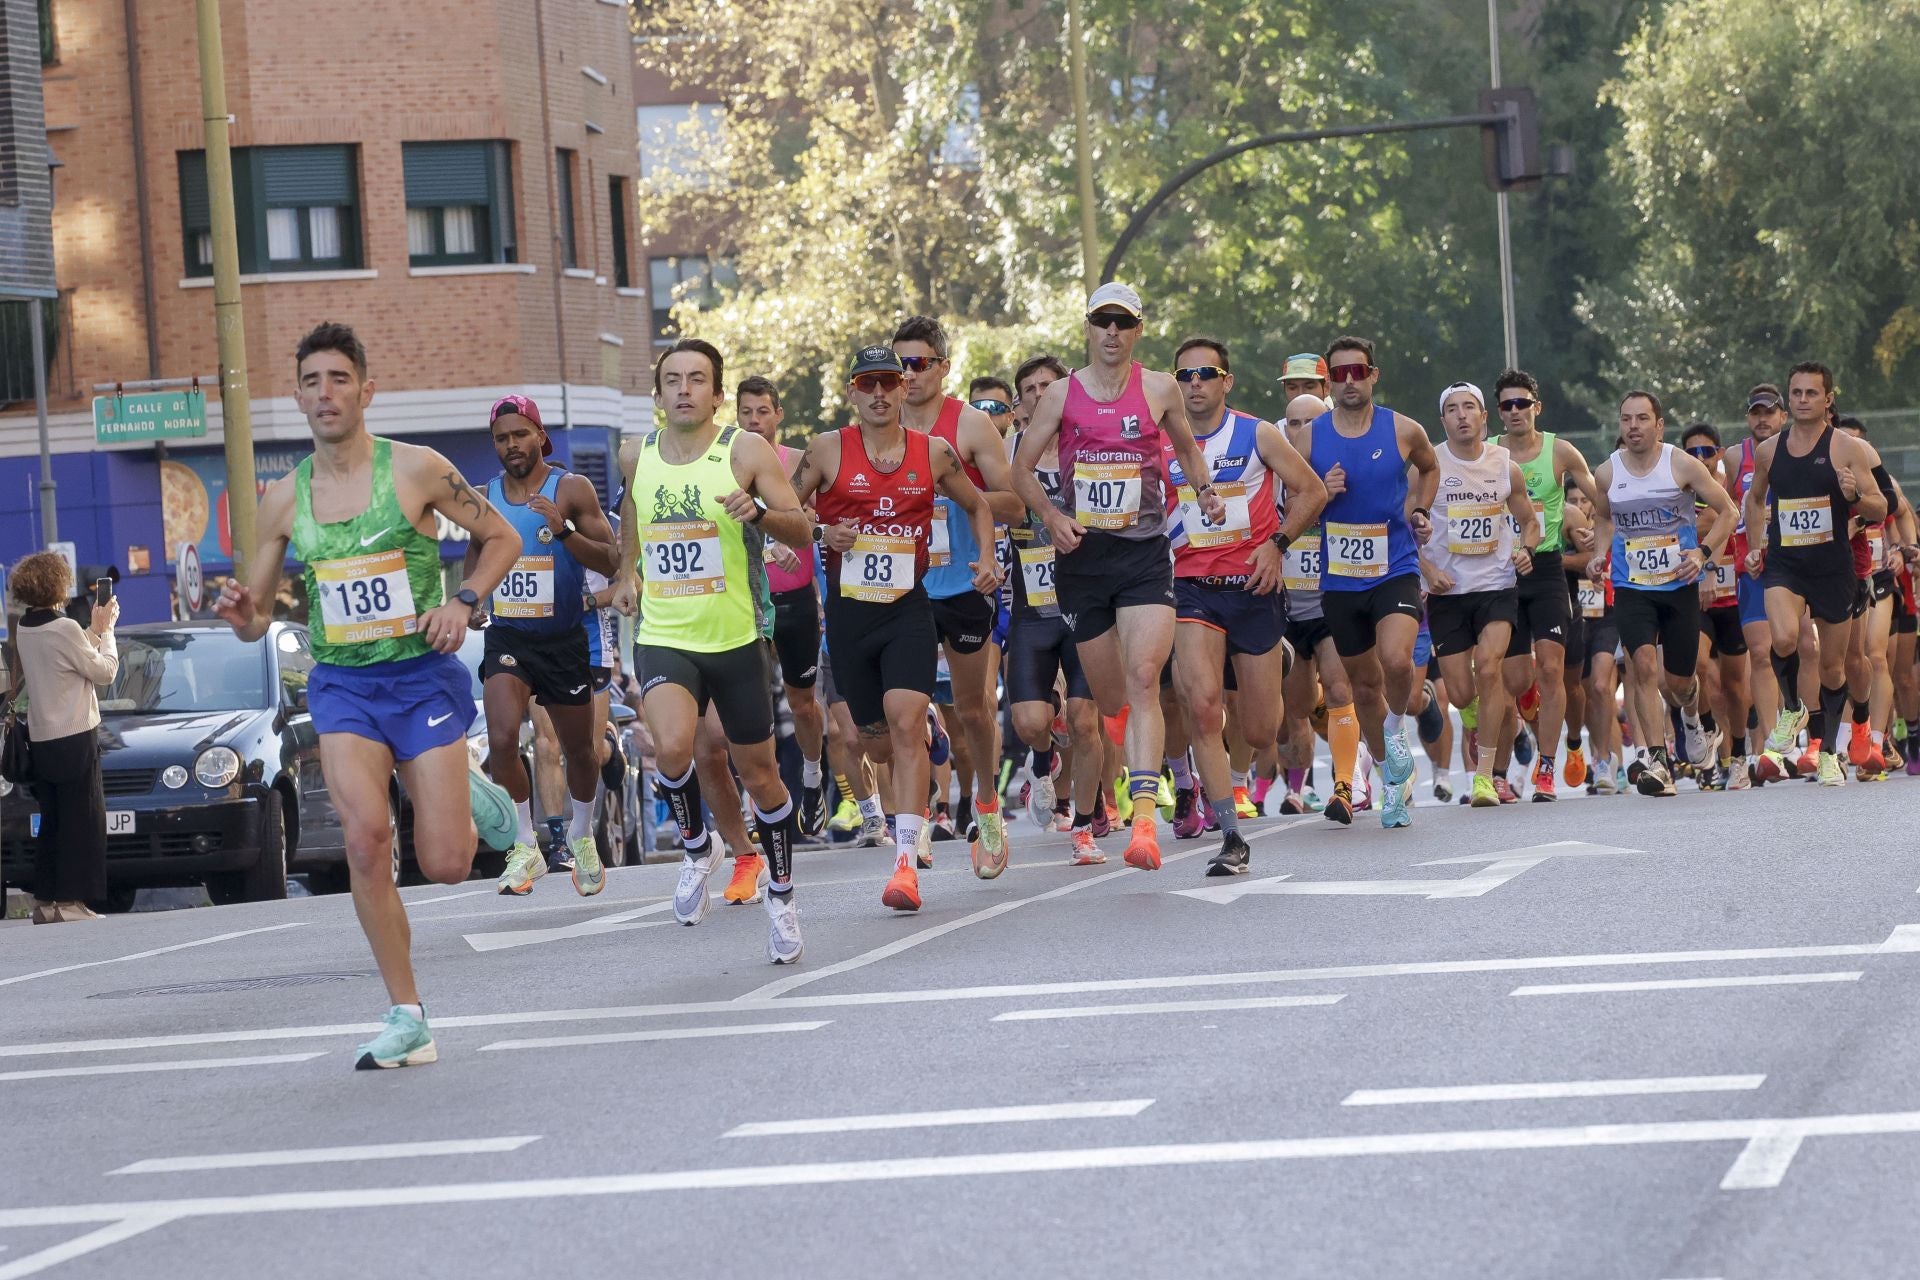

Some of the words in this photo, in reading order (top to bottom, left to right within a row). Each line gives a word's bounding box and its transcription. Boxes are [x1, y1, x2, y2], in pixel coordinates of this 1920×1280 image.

[129, 402, 163, 414] CALLE
[173, 400, 186, 411] DE
[101, 421, 155, 434] FERNANDO
[1217, 457, 1244, 469] Toscaf
[1088, 480, 1126, 508] 407
[873, 509, 896, 517] Beco
[1789, 509, 1821, 531] 432
[1090, 517, 1124, 527] aviles
[1460, 517, 1492, 539] 226
[1200, 534, 1234, 546] aviles
[1793, 536, 1820, 545] aviles
[1340, 537, 1374, 560] 228
[656, 541, 704, 574] 392
[1300, 551, 1321, 574] 53
[1636, 547, 1670, 571] 254
[864, 553, 893, 582] 83
[1342, 567, 1373, 576] aviles
[501, 572, 538, 598] 365
[663, 583, 705, 596] aviles
[336, 577, 391, 617] 138
[857, 591, 896, 601] aviles
[502, 606, 536, 616] aviles
[345, 625, 394, 640] aviles
[959, 634, 983, 643] Joma
[110, 813, 131, 831] JP
